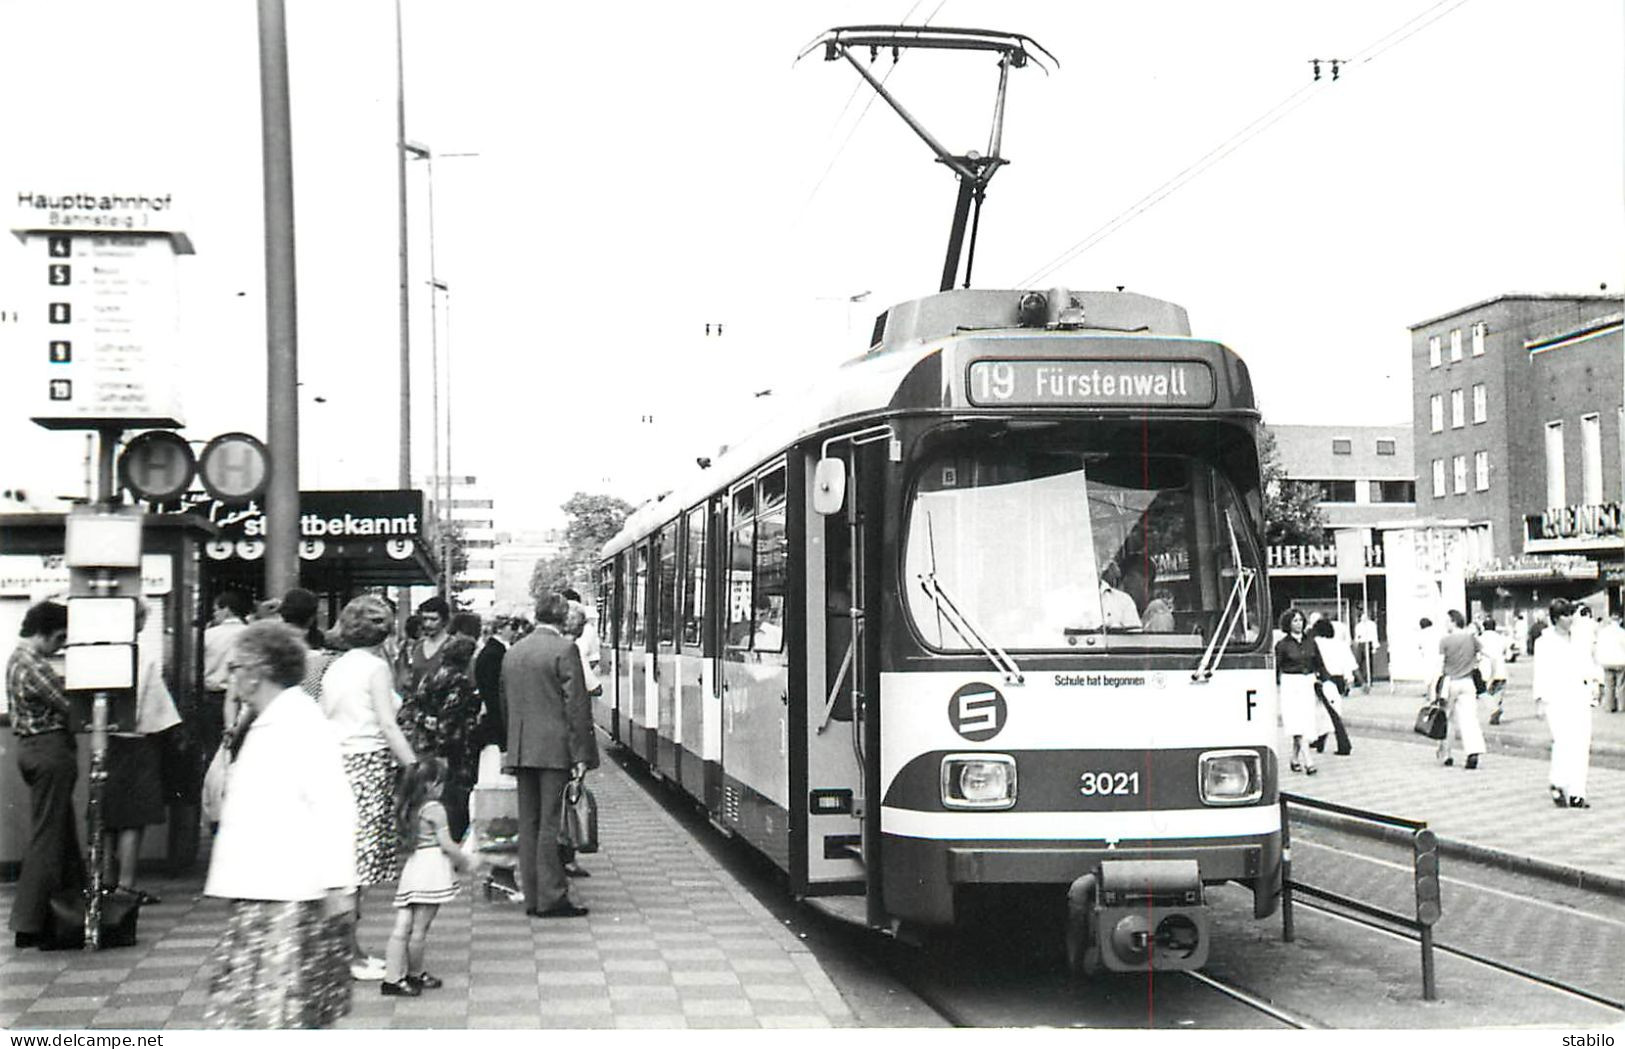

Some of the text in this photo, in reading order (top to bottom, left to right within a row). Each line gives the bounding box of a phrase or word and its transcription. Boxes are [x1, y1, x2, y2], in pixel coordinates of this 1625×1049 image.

[18, 192, 172, 211] Hauptbahnhof
[976, 363, 1187, 400] 19 Fürstenwall
[1054, 674, 1146, 688] Schule hat begonnen
[1246, 689, 1258, 722] F
[1080, 771, 1140, 796] 3021
